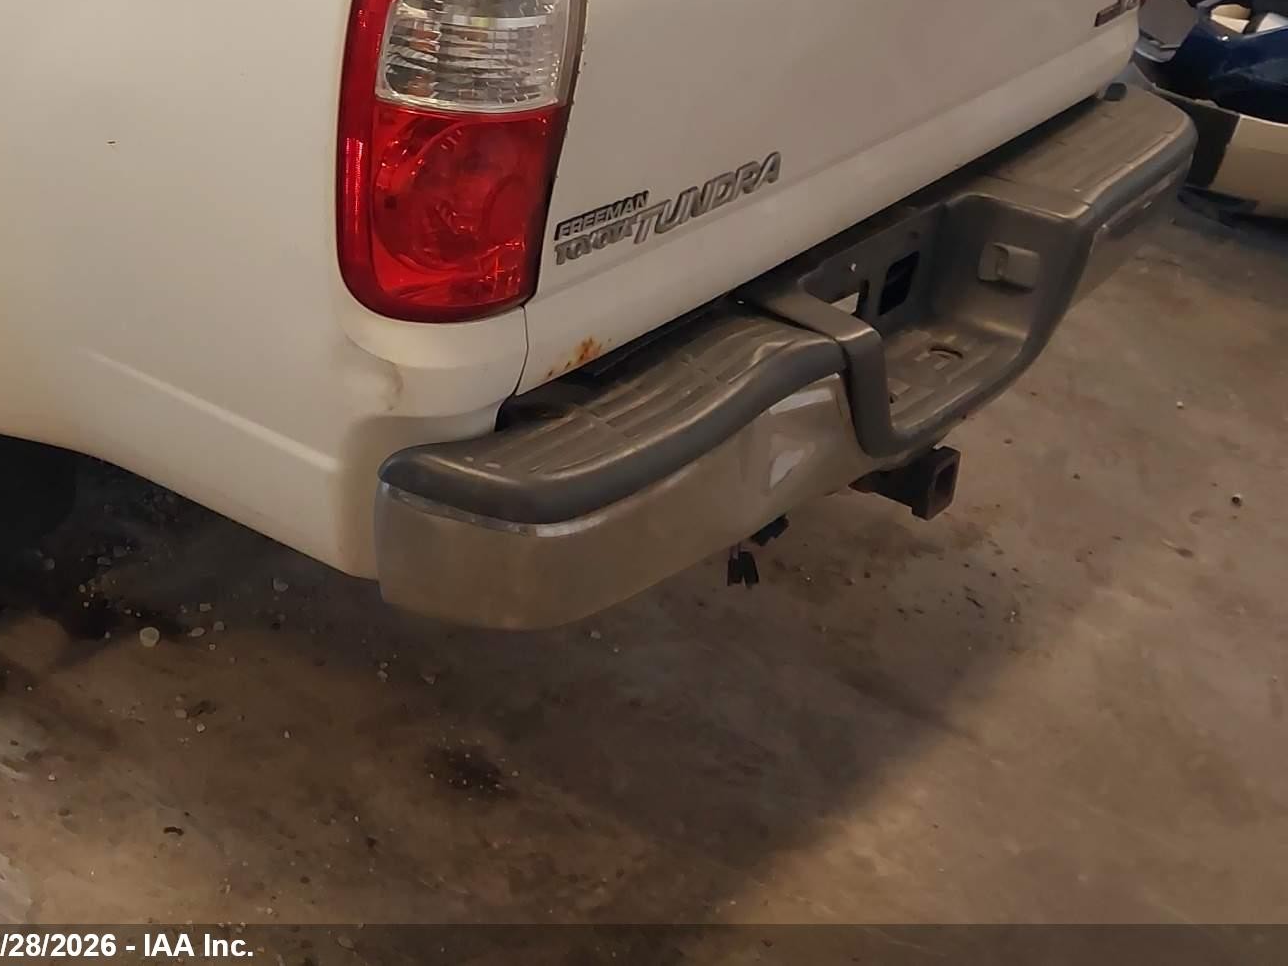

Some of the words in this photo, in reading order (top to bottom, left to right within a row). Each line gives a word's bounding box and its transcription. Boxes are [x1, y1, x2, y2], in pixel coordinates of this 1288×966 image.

[554, 216, 639, 265] TOYOTA
[633, 151, 781, 244] TUNDRA
[554, 190, 649, 241] FREEMAN
